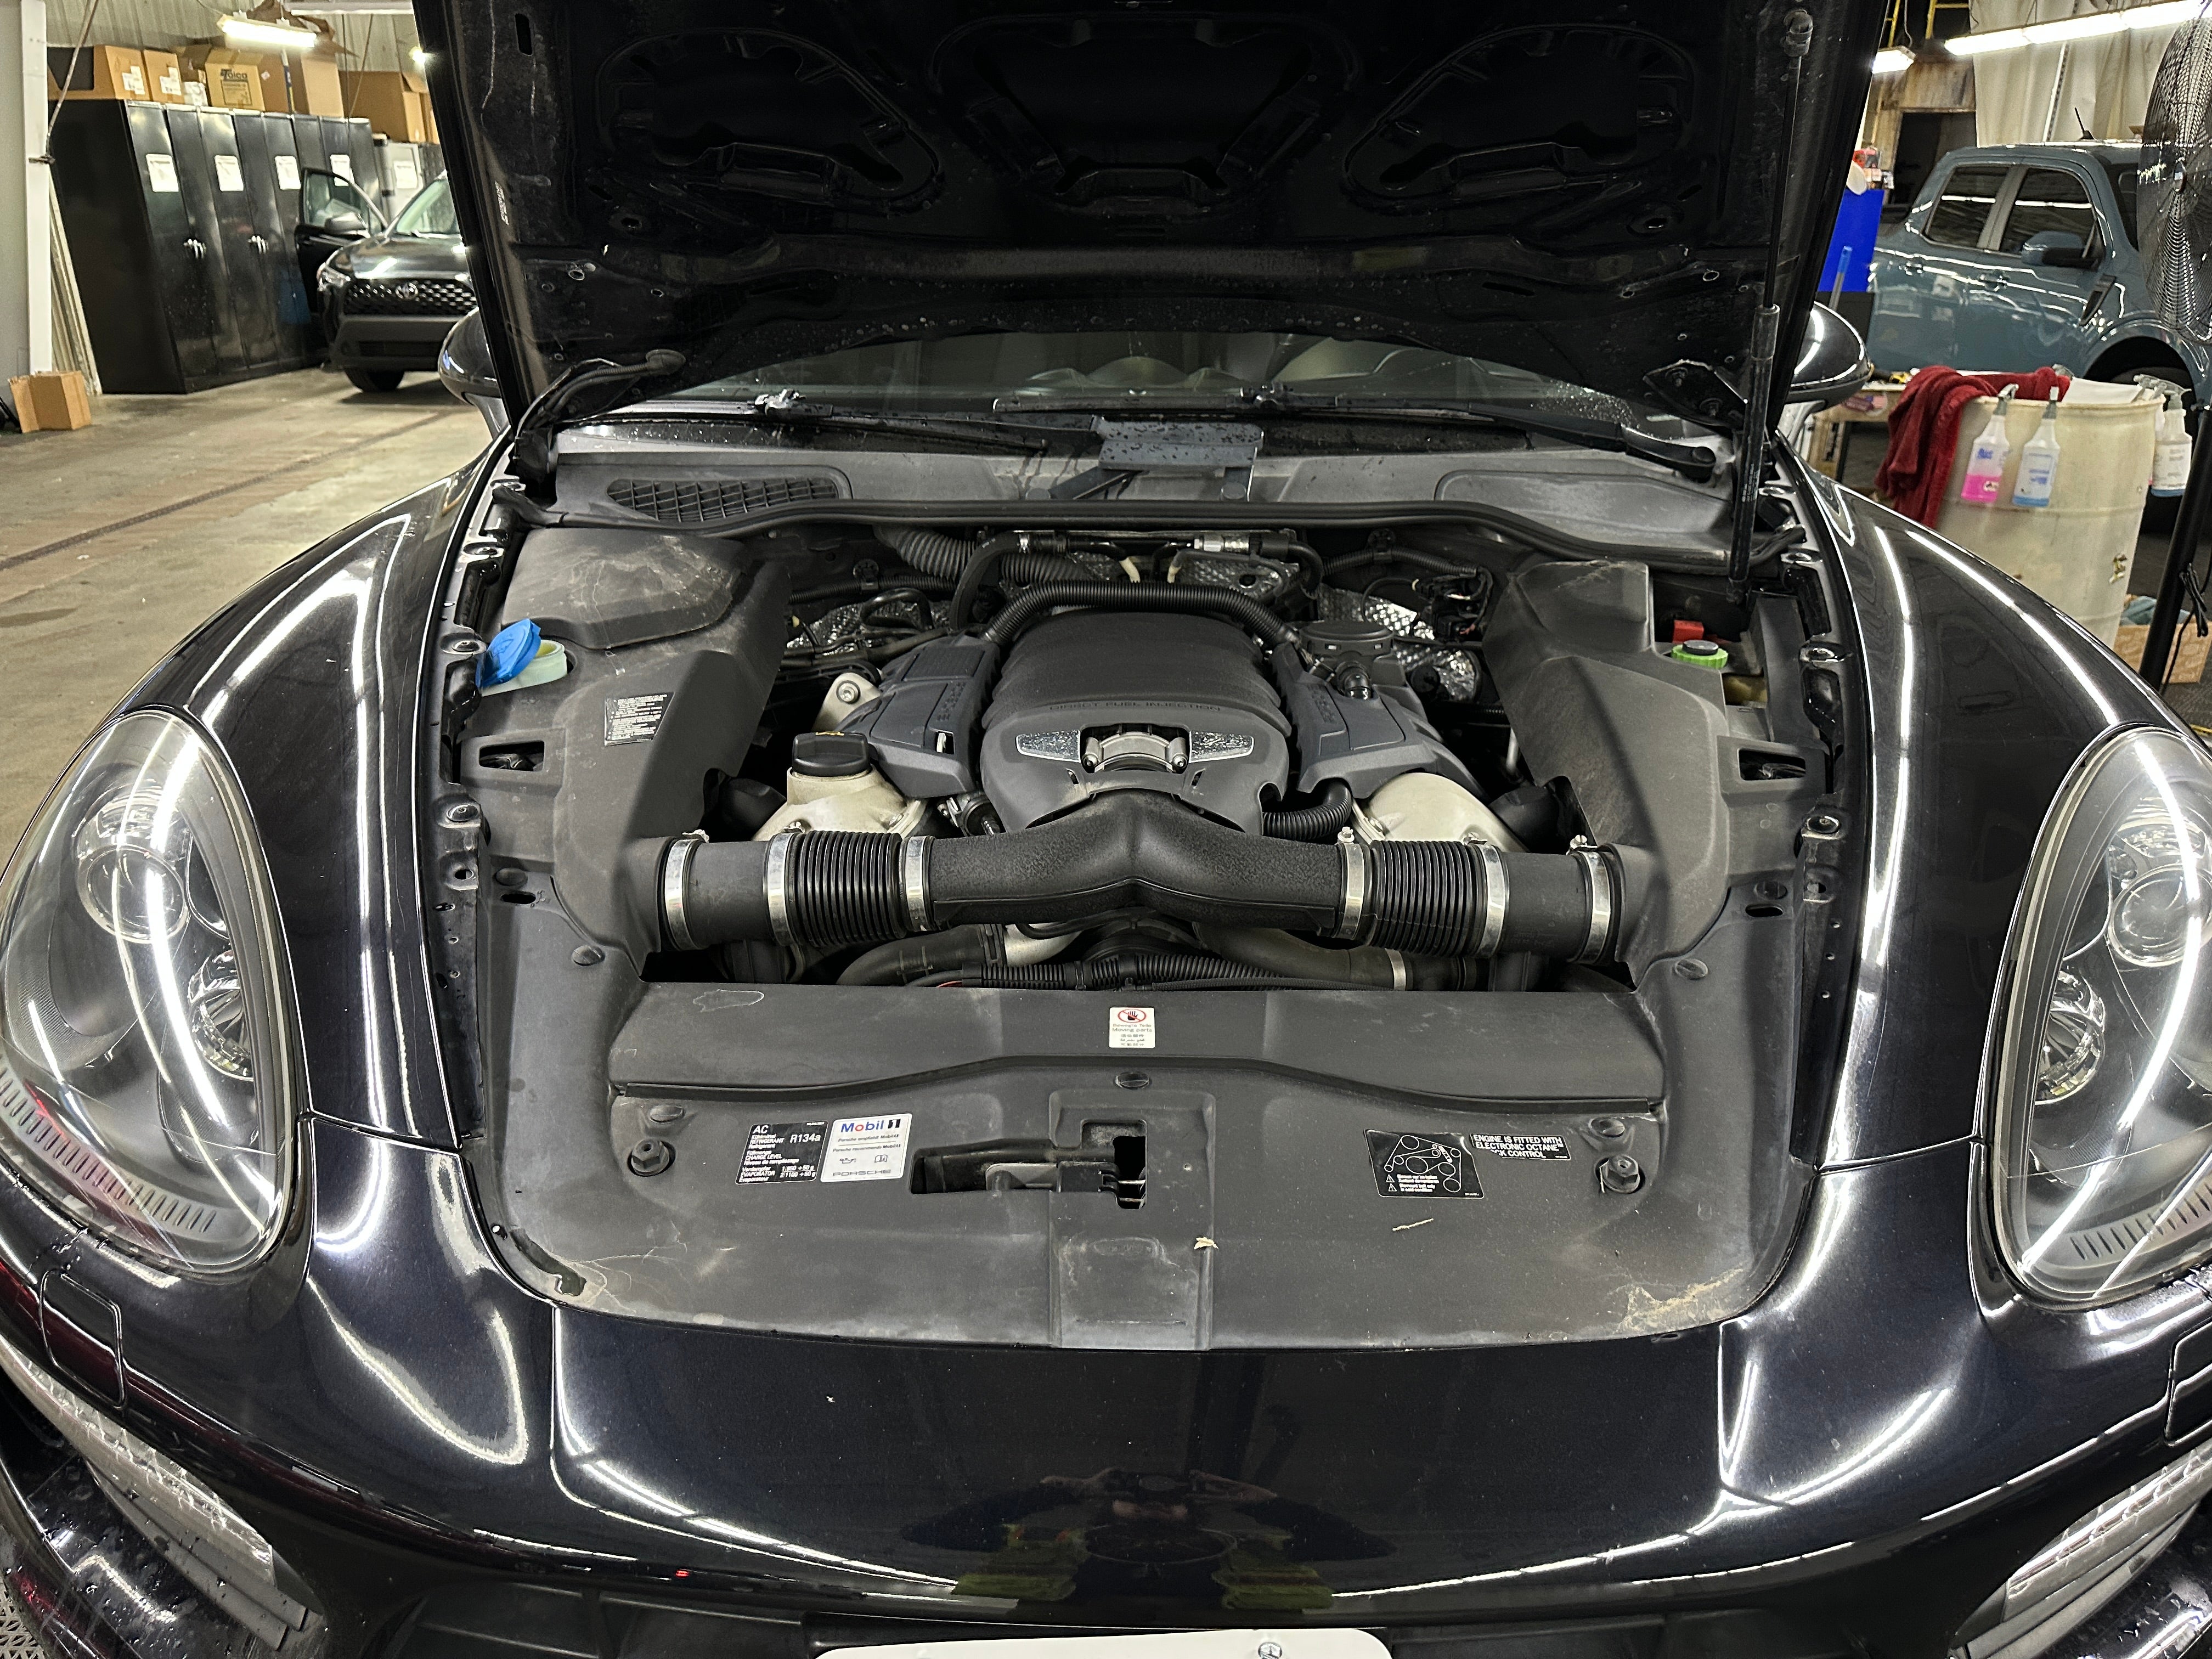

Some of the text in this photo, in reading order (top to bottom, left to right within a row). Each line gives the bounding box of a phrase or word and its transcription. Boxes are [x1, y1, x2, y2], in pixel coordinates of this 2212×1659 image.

[753, 1125, 769, 1134] AC
[840, 1120, 884, 1132] Mobil
[790, 1133, 821, 1143] R134a
[1473, 1135, 1503, 1143] ENGINE
[1476, 1142, 1525, 1150] ELECTRONIC
